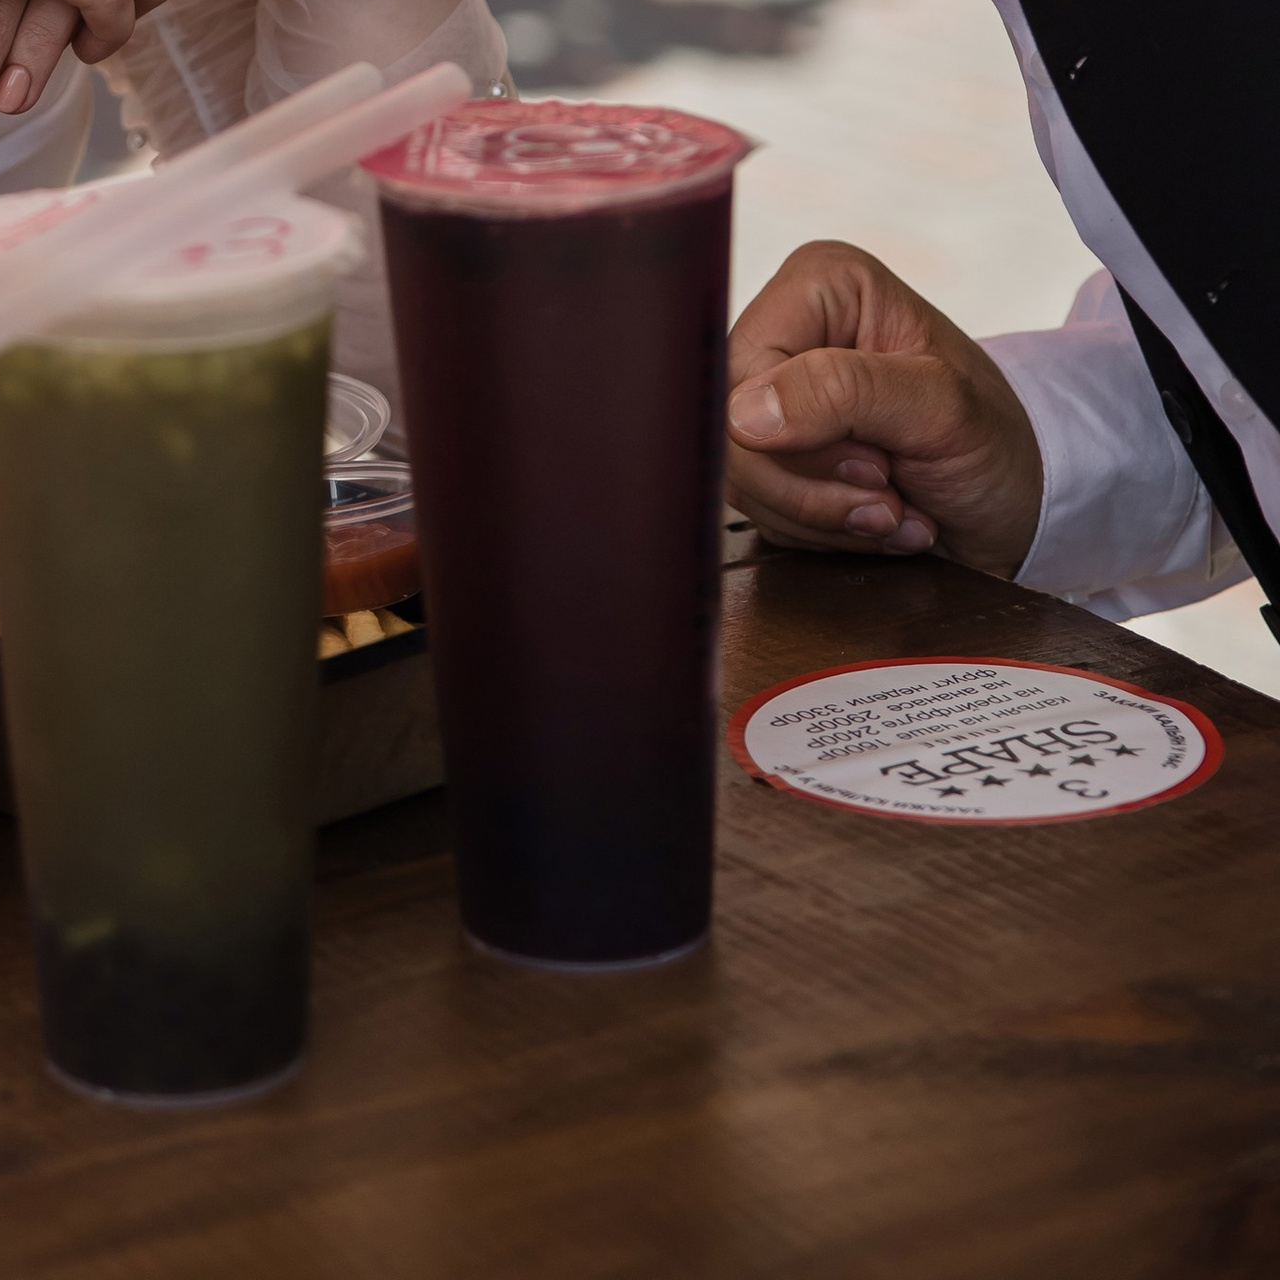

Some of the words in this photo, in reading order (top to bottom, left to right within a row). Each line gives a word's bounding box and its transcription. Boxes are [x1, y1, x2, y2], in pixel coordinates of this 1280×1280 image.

[931, 669, 997, 688] фрукт
[980, 680, 1011, 691] на
[845, 684, 928, 707] недели
[887, 687, 979, 712] ананасе
[1013, 687, 1044, 698] на
[770, 703, 845, 728] 3300Р
[881, 694, 1012, 729] грейпфруте
[991, 696, 1071, 718] кальян
[1093, 691, 1160, 713] ЗАКАЖИ
[1152, 713, 1187, 745] КАЛЬЯН
[806, 709, 881, 734] 2900Р
[895, 723, 959, 741] чаше
[959, 715, 990, 726] на
[807, 725, 880, 749] 2400Р
[917, 725, 1015, 749] LOUNGE
[817, 739, 891, 762] 1600Р
[879, 720, 1118, 787] SHAPE
